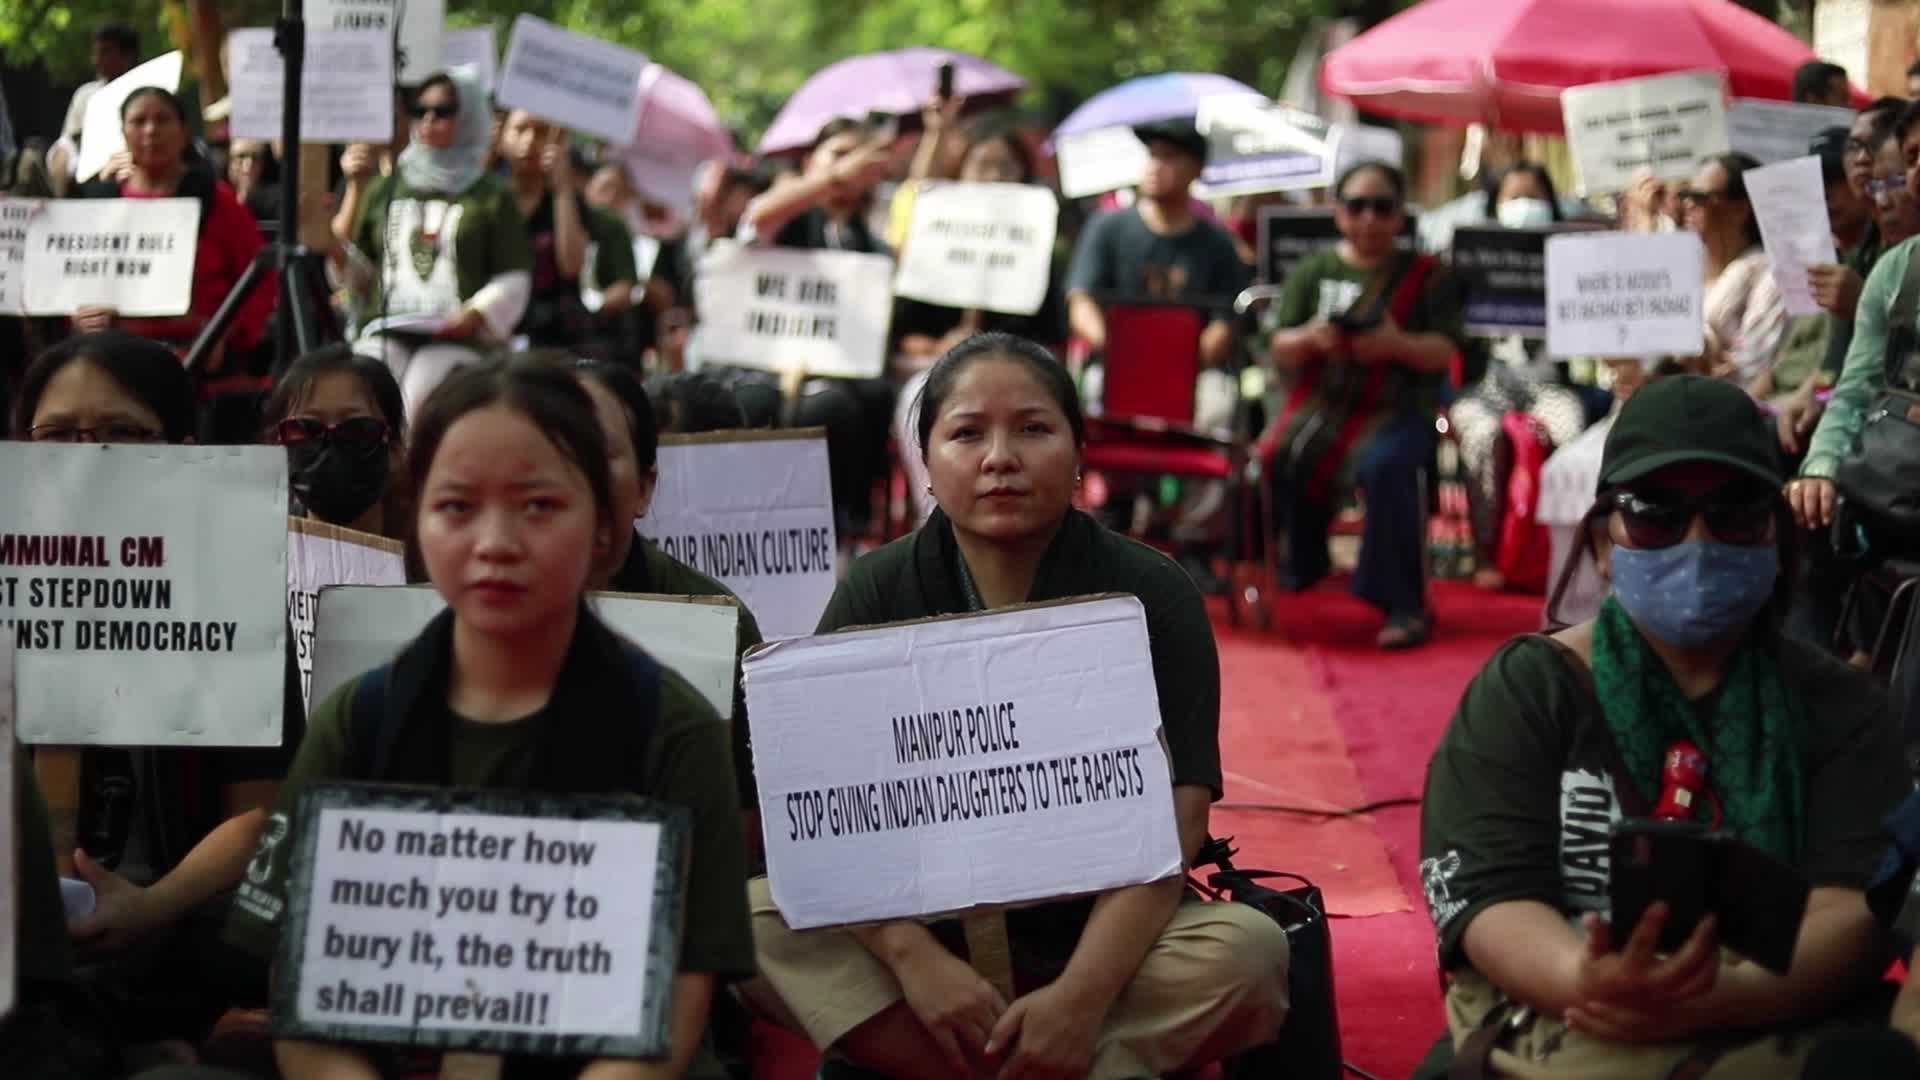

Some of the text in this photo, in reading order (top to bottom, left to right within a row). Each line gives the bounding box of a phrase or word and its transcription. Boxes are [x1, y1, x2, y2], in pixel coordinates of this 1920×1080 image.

[47, 233, 129, 251] PRESIDENT
[116, 258, 151, 275] NOW
[120, 536, 165, 567] CM
[702, 532, 758, 577] INDIAN
[762, 527, 830, 574] CULTURE
[29, 577, 171, 609] STEPDOWN
[76, 621, 237, 651] DEMOCRACY
[892, 702, 1019, 764] MANIPUR POLICE
[786, 748, 1144, 841] STOP GIVING INDIAN DAUGHTERS TO THE RAPISTS
[337, 818, 596, 867] No matter how
[330, 877, 598, 924] much you try to
[323, 925, 612, 975] bury it, the truth
[315, 980, 550, 1028] shall prevail!
